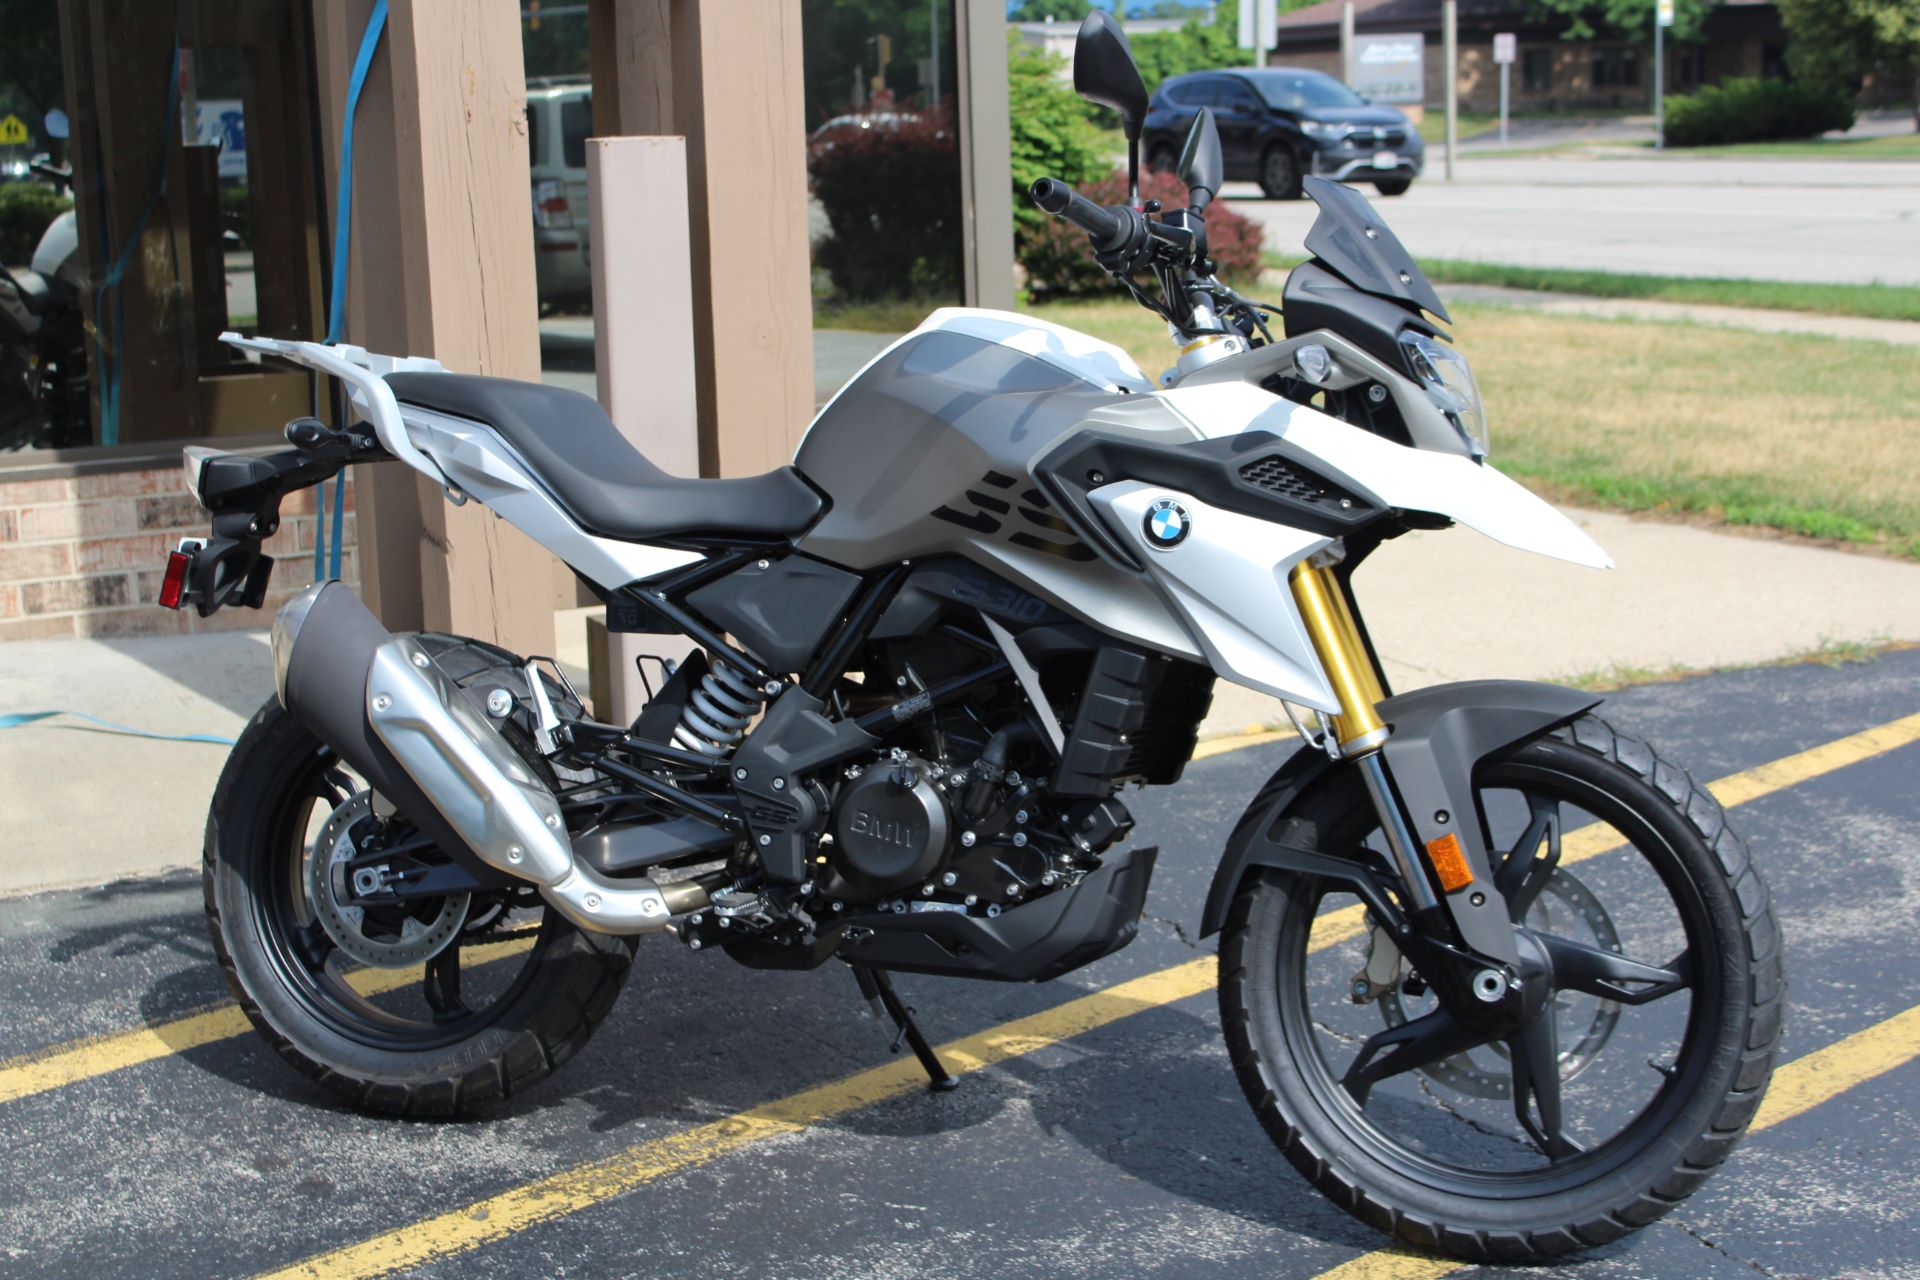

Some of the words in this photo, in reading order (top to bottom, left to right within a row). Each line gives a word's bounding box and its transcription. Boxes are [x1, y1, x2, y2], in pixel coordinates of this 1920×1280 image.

[1151, 500, 1190, 522] BMW
[985, 588, 1047, 620] 310
[849, 809, 914, 849] BMW
